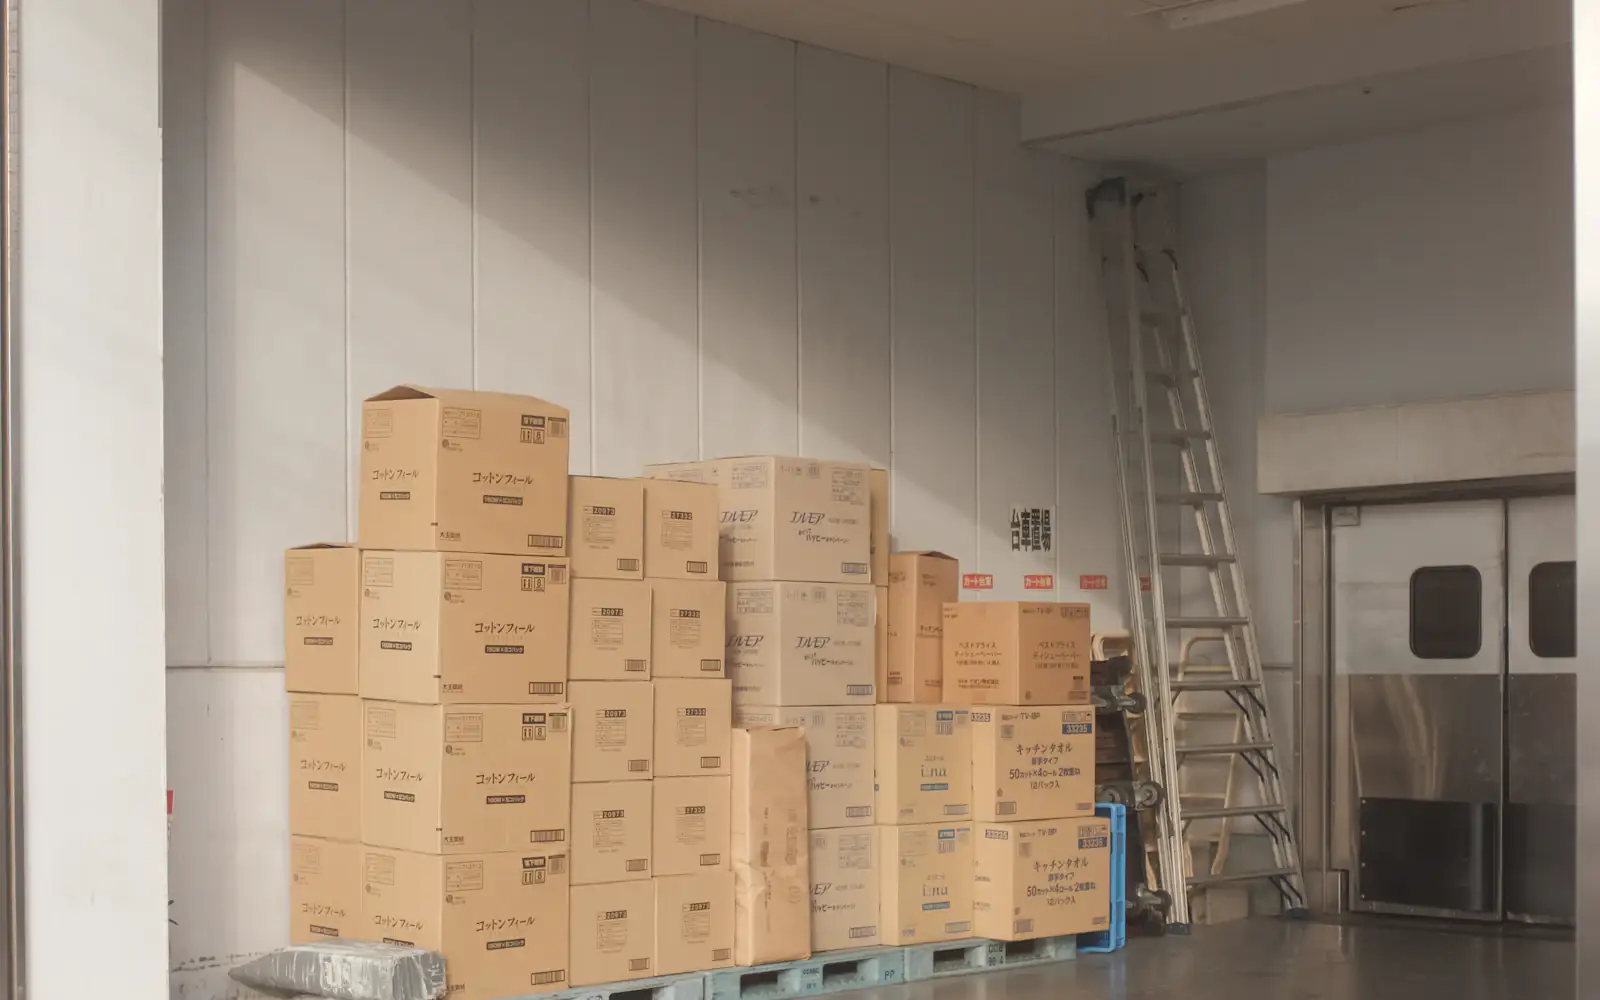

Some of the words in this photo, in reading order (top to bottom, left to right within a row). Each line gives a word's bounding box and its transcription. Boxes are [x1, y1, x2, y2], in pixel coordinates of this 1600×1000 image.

[371, 467, 419, 481] コットンフィール
[472, 471, 534, 485] コットンフィール
[720, 509, 758, 523] エルモア
[790, 510, 826, 525] エルモア
[1011, 508, 1051, 552] 台車置場
[602, 608, 623, 616] 20973
[296, 615, 341, 626] コットンフィール
[372, 618, 422, 631] コットンフィール
[474, 621, 535, 634] コットンフィール
[795, 636, 831, 649] エルモア
[1066, 725, 1088, 733] 33235
[1016, 741, 1073, 755] キッチンタオル
[375, 767, 423, 782] コットンフィール
[475, 772, 536, 785] コットンフィール
[1034, 857, 1089, 873] キッチンタオル
[374, 914, 423, 930] コットンフィール
[475, 915, 536, 932] コットンフィール
